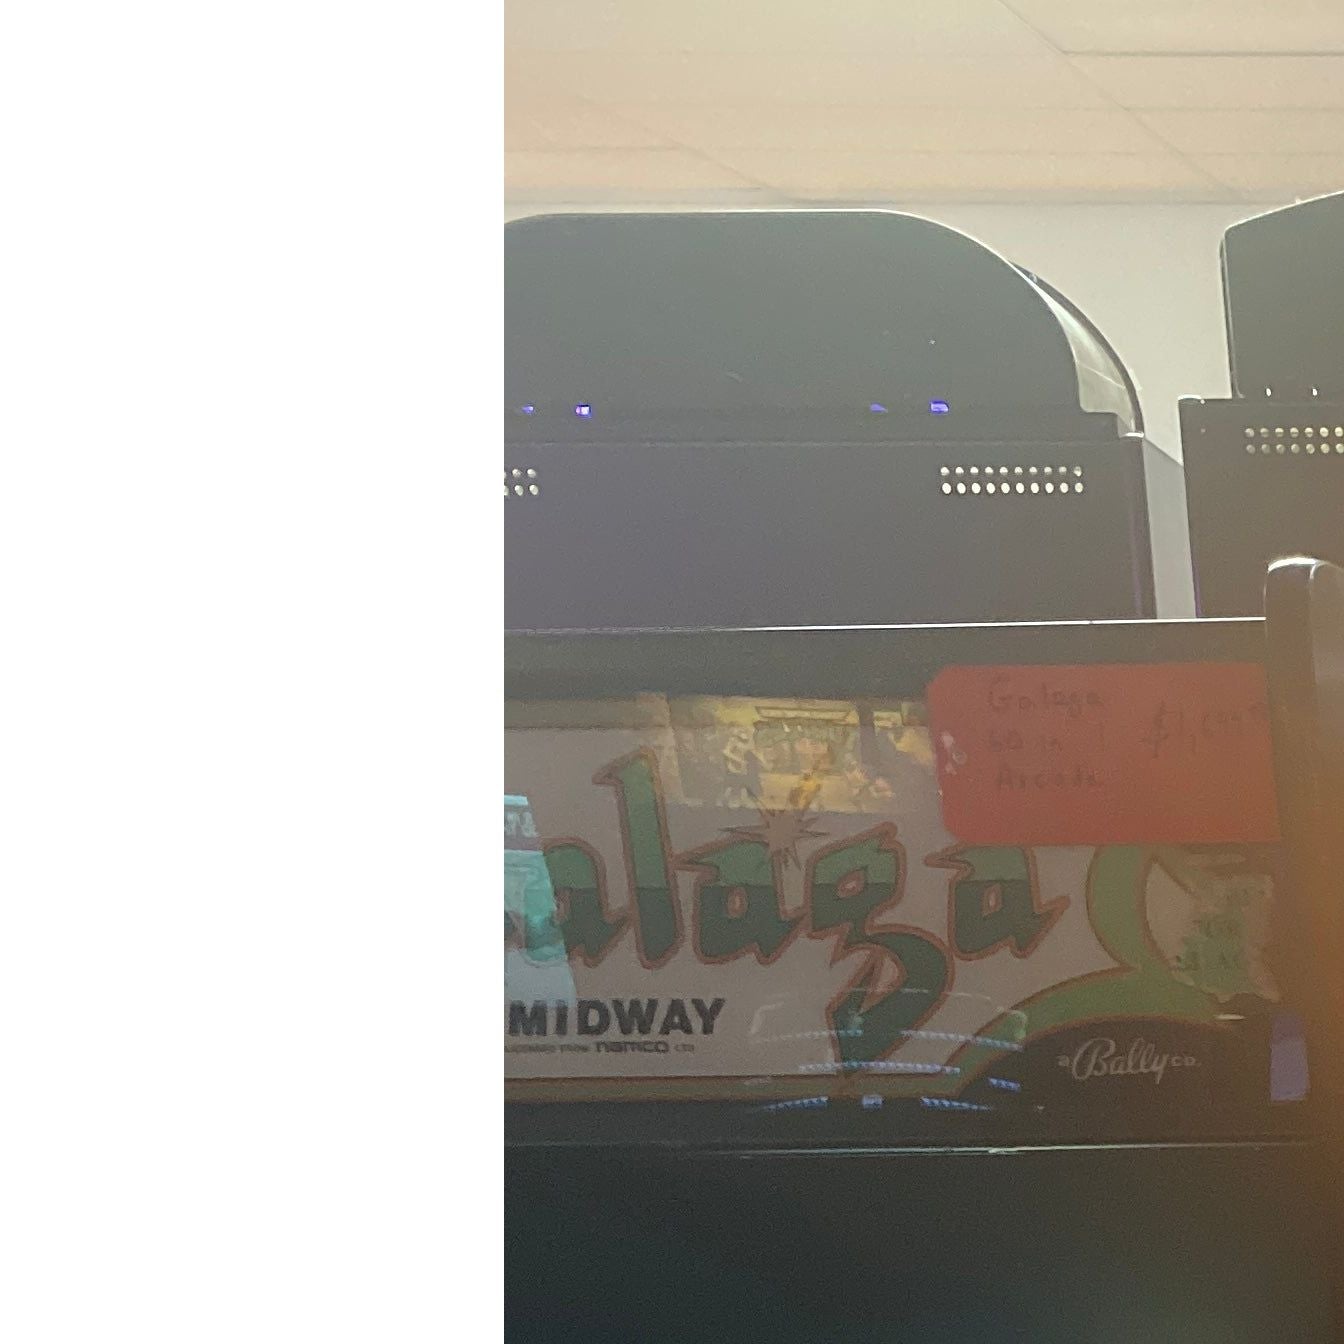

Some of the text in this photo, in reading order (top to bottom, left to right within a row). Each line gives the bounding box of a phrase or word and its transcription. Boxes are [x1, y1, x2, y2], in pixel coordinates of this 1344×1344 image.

[988, 673, 1105, 718] Galaga
[995, 761, 1104, 791] Arcade
[505, 746, 1070, 1078] alaga
[507, 997, 725, 1037] MIDWAY
[595, 1041, 670, 1054] namco
[1071, 1036, 1170, 1085] Bally
